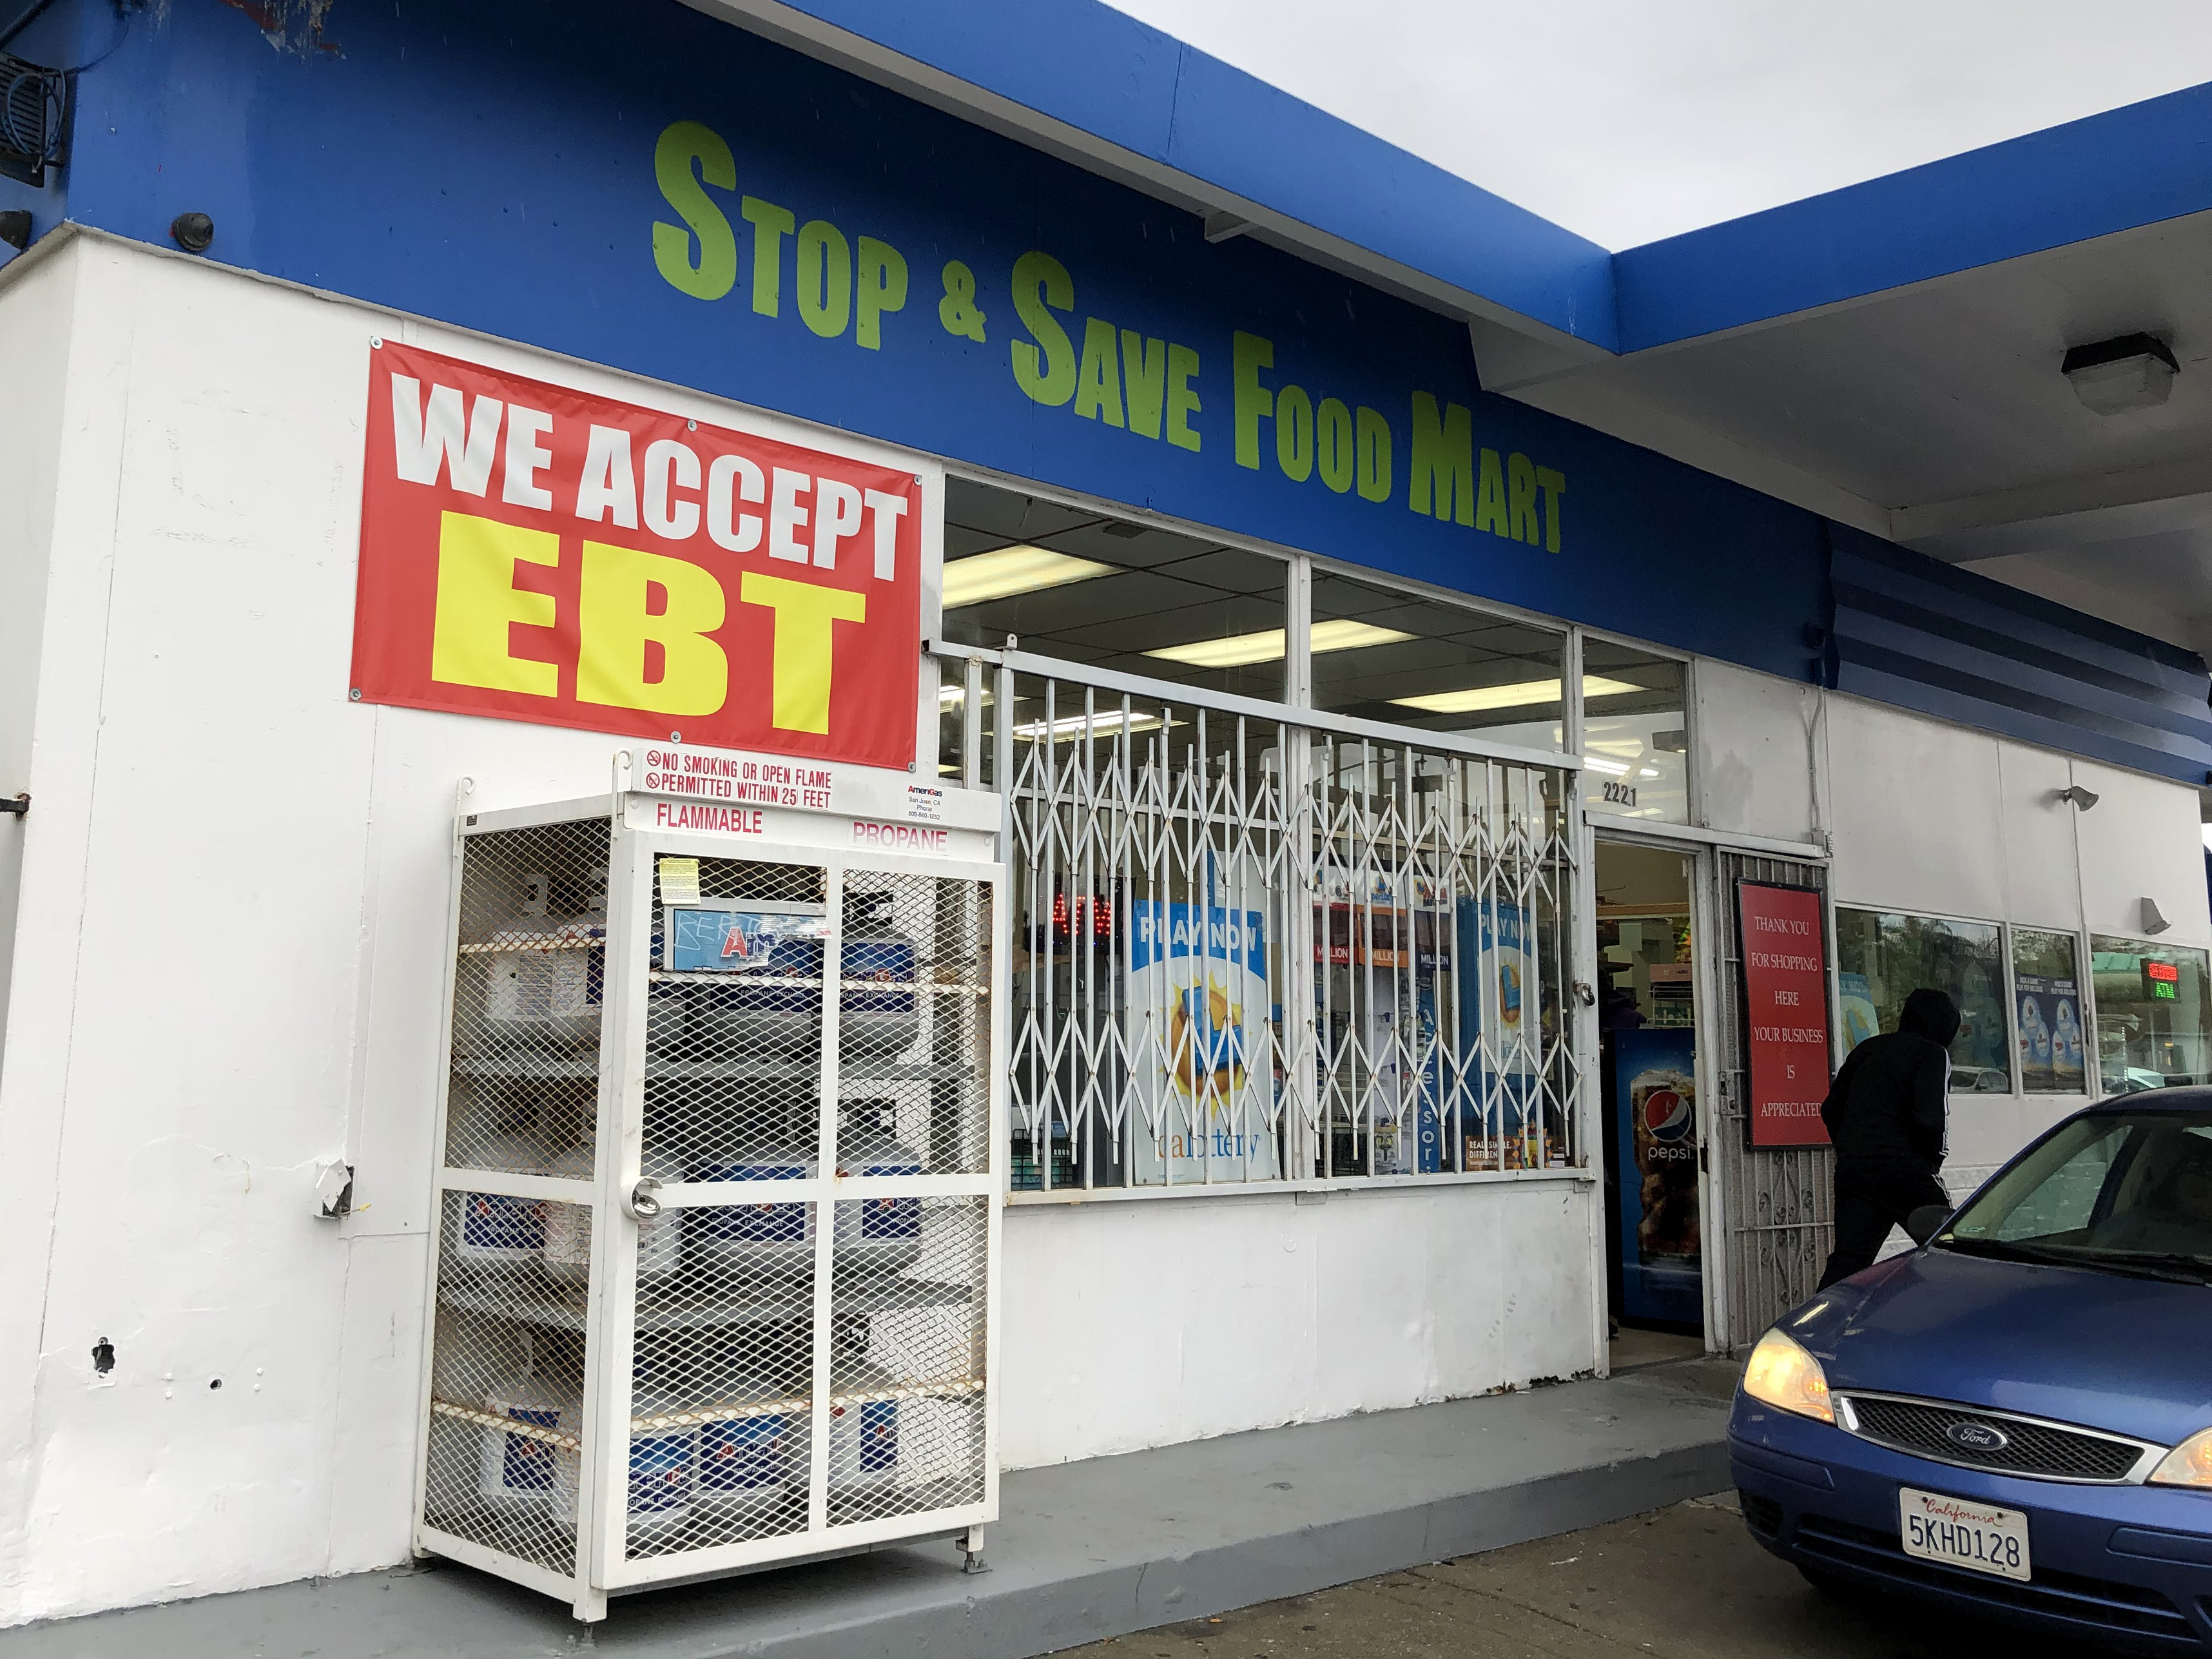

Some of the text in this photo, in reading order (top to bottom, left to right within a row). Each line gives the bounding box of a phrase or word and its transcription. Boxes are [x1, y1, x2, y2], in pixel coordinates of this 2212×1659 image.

[939, 259, 986, 344] &
[391, 372, 908, 582] WE ACCEPT
[431, 510, 866, 735] EBT
[663, 752, 832, 790] NO SMOKING OR OPEN FLAME
[661, 773, 831, 808] PERMITTED WITHIN 25 FEET
[907, 785, 943, 797] AmeriGas
[1604, 781, 1636, 807] 2221
[657, 802, 763, 834] FLAMMABLE
[853, 820, 948, 853] PROPANE
[1754, 916, 1809, 935] THANK YOU
[1751, 952, 1818, 971] FOR SHOPPING
[1774, 991, 1800, 1006] HERE
[1753, 1027, 1823, 1043] YOUR BUSINESS
[1787, 1065, 1796, 1079] IS
[1761, 1102, 1822, 1117] APPRECIATED
[1648, 1146, 1691, 1162] pepsi
[1959, 1427, 1992, 1446] Ford
[1925, 1499, 2004, 1528] California
[1909, 1514, 2021, 1567] 5KHD128
